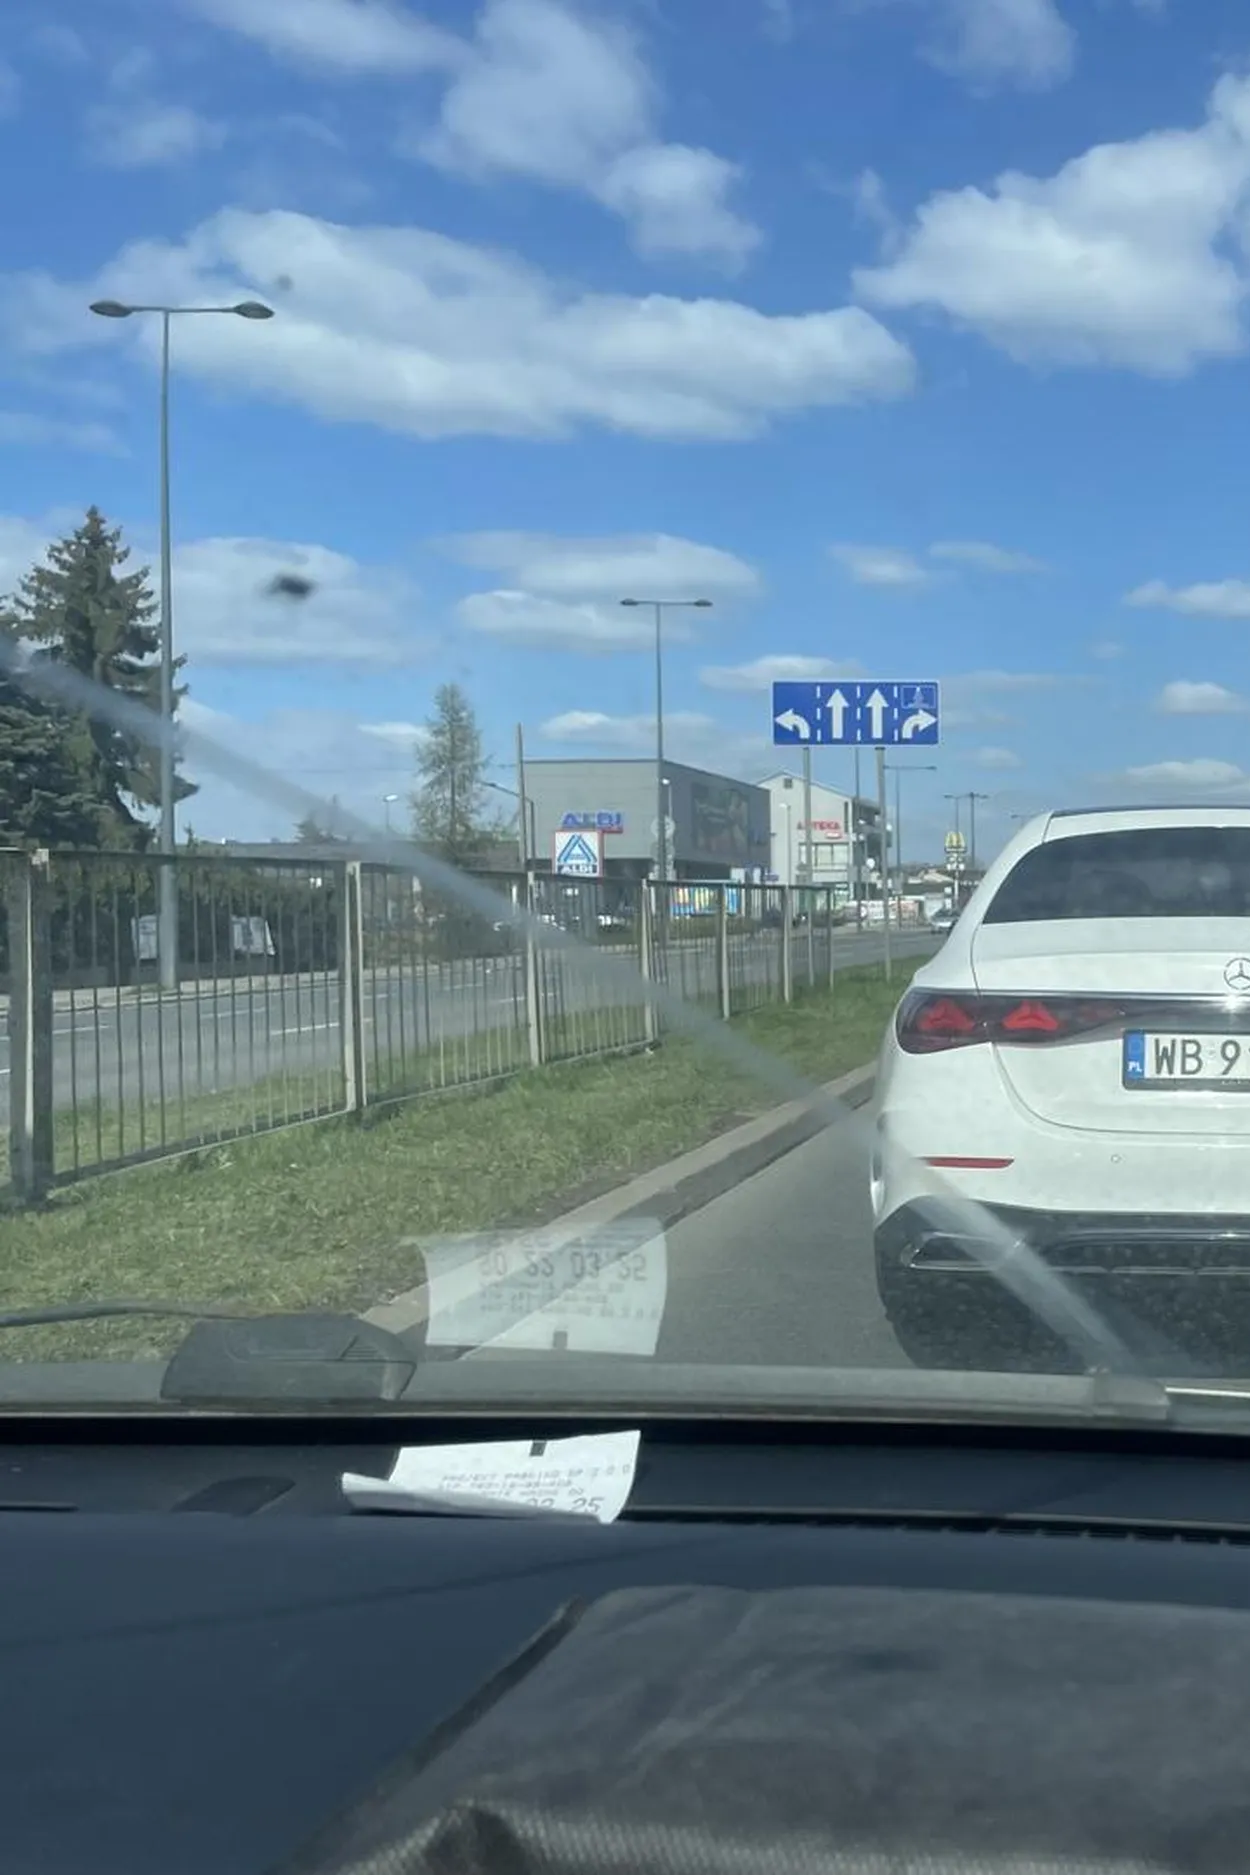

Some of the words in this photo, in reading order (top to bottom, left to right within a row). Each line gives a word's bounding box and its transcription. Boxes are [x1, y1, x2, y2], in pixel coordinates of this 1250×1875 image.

[562, 811, 623, 828] ALDI
[797, 820, 841, 830] ATEKA
[1153, 1038, 1204, 1076] WB
[1127, 1061, 1142, 1072] PL
